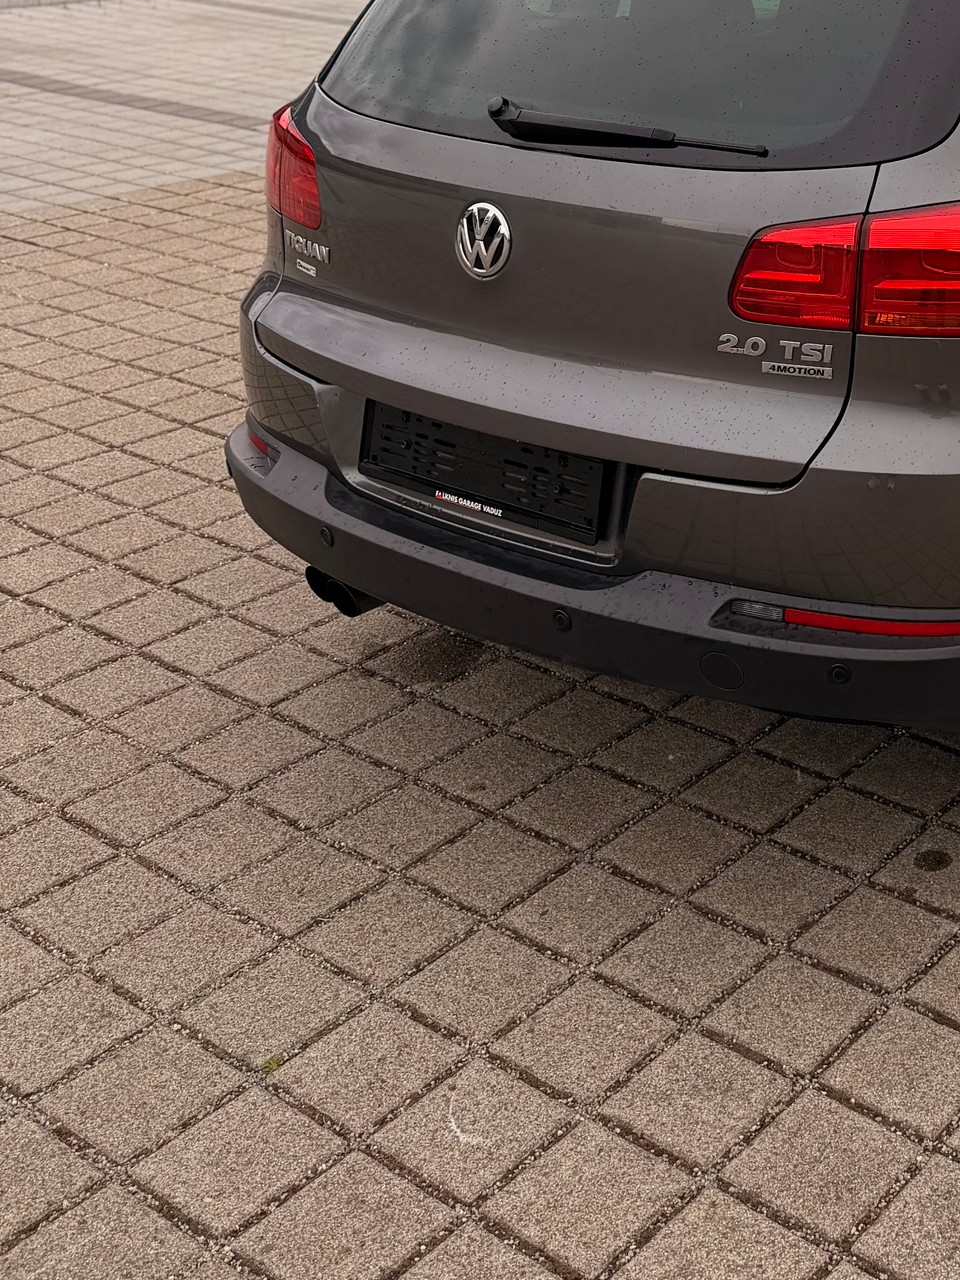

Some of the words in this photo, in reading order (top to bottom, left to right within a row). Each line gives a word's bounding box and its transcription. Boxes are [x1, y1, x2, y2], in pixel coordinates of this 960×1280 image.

[285, 229, 330, 264] TIGUAN
[717, 333, 767, 356] 2.0
[779, 340, 834, 364] TSI
[768, 364, 825, 377] 4MOTION
[458, 497, 482, 512] GARAGE
[482, 504, 503, 517] VADUZ
